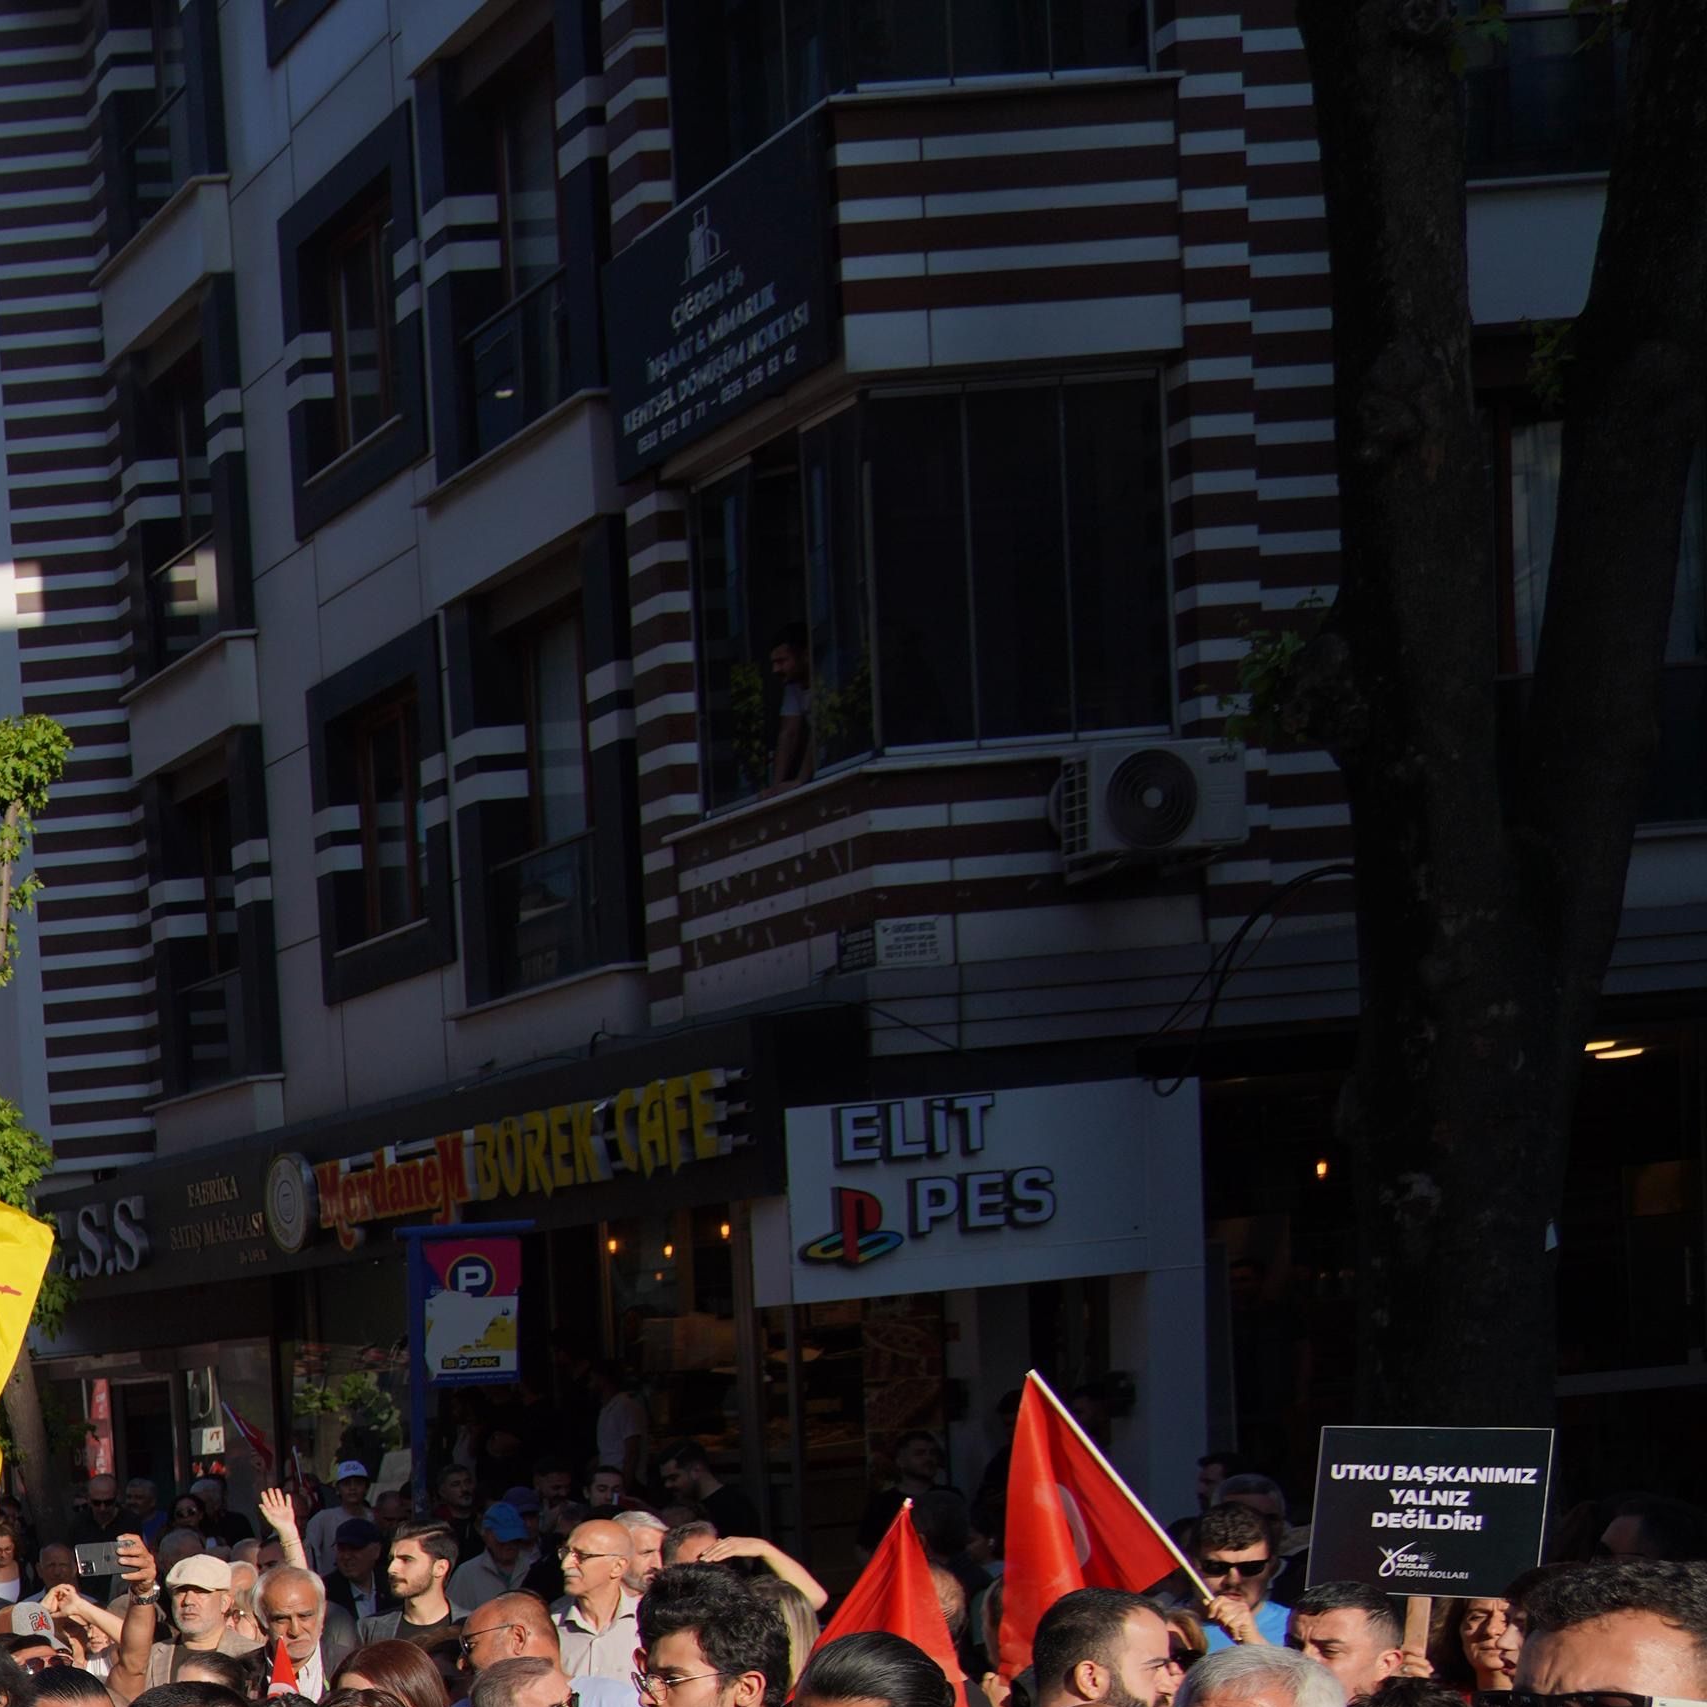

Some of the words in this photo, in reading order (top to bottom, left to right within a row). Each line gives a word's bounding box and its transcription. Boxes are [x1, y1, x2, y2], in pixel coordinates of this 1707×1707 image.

[474, 1099, 603, 1200] BÖREK
[614, 1068, 721, 1179] CAFE
[187, 1172, 240, 1208] FABRİKA
[908, 1166, 1056, 1238] PES
[1331, 1464, 1389, 1481] UTKU
[1393, 1465, 1537, 1485] BAŞKANIMIZ
[1389, 1489, 1470, 1507] YALNIZ
[1371, 1509, 1483, 1531] DEĞİLDİR!
[1398, 1553, 1420, 1563] CHP
[1395, 1569, 1427, 1578] KADIN
[1428, 1571, 1469, 1580] KOLLARI
